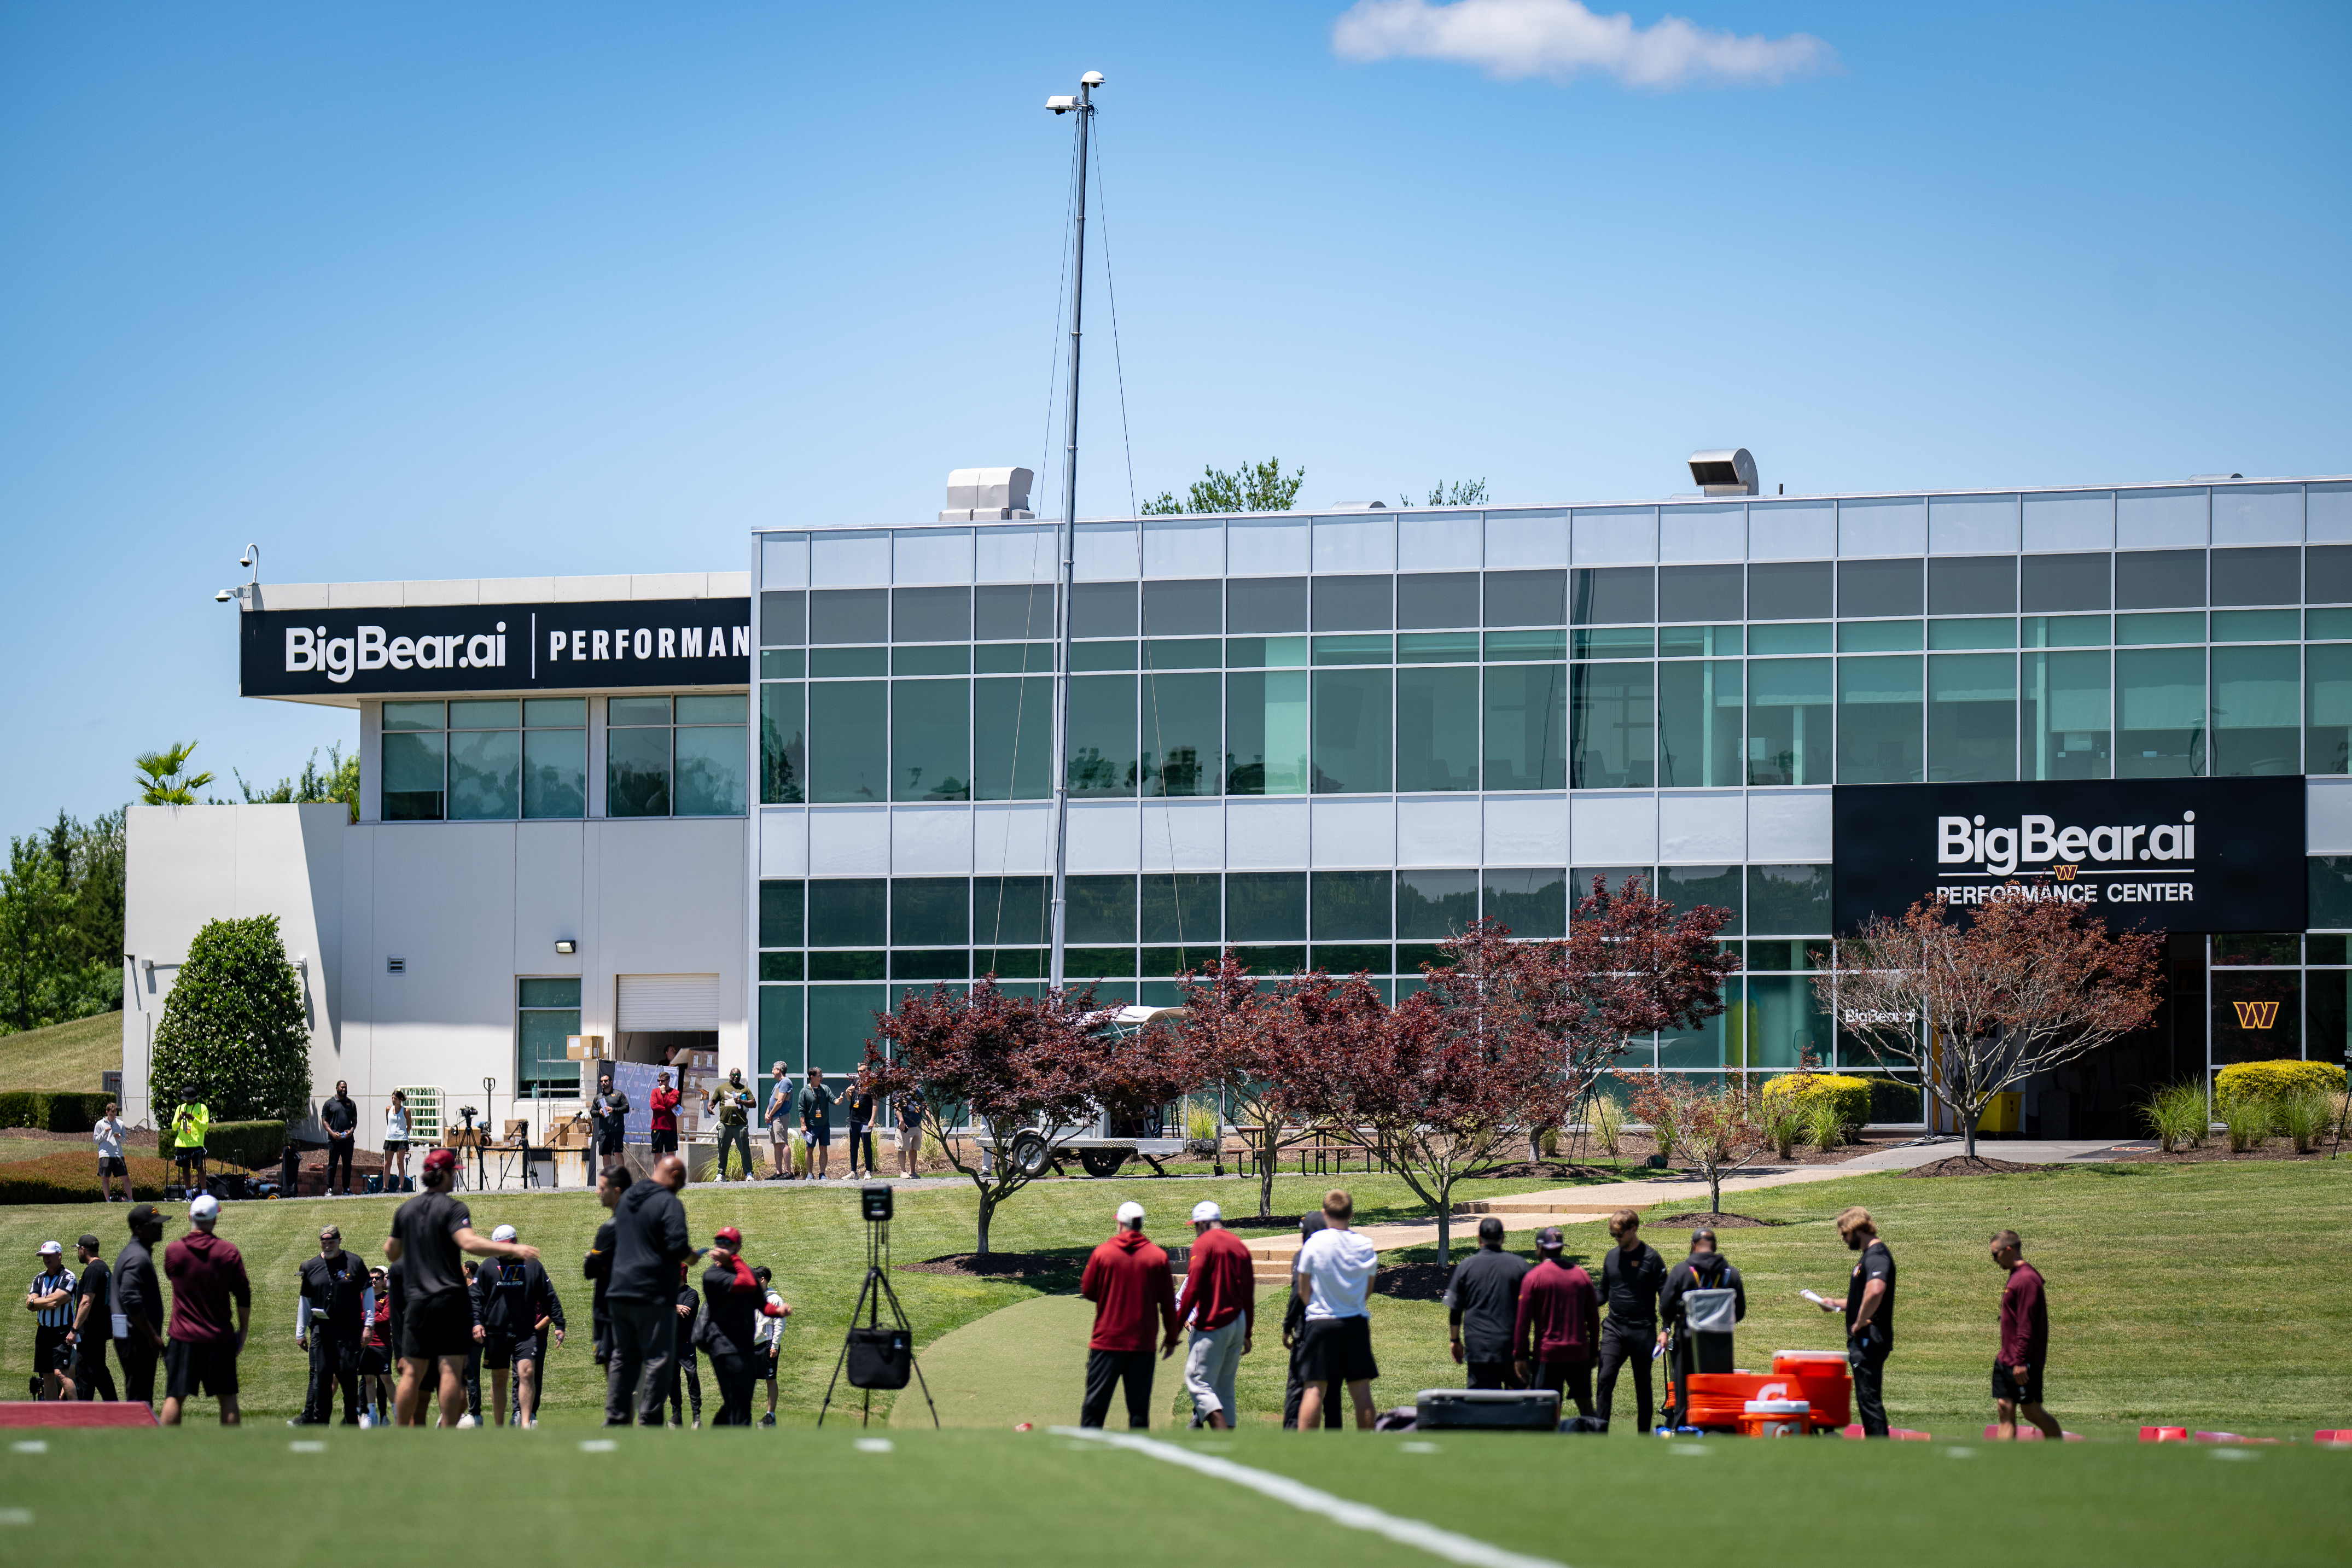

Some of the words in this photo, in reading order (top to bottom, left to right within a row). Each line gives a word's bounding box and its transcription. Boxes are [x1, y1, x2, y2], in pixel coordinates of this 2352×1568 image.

[286, 621, 506, 683] BigBear.ai
[550, 626, 749, 661] PERFORMAN
[1938, 811, 2195, 875] BigBear.ai
[2107, 883, 2193, 902] CENTER
[2233, 1001, 2280, 1029] W
